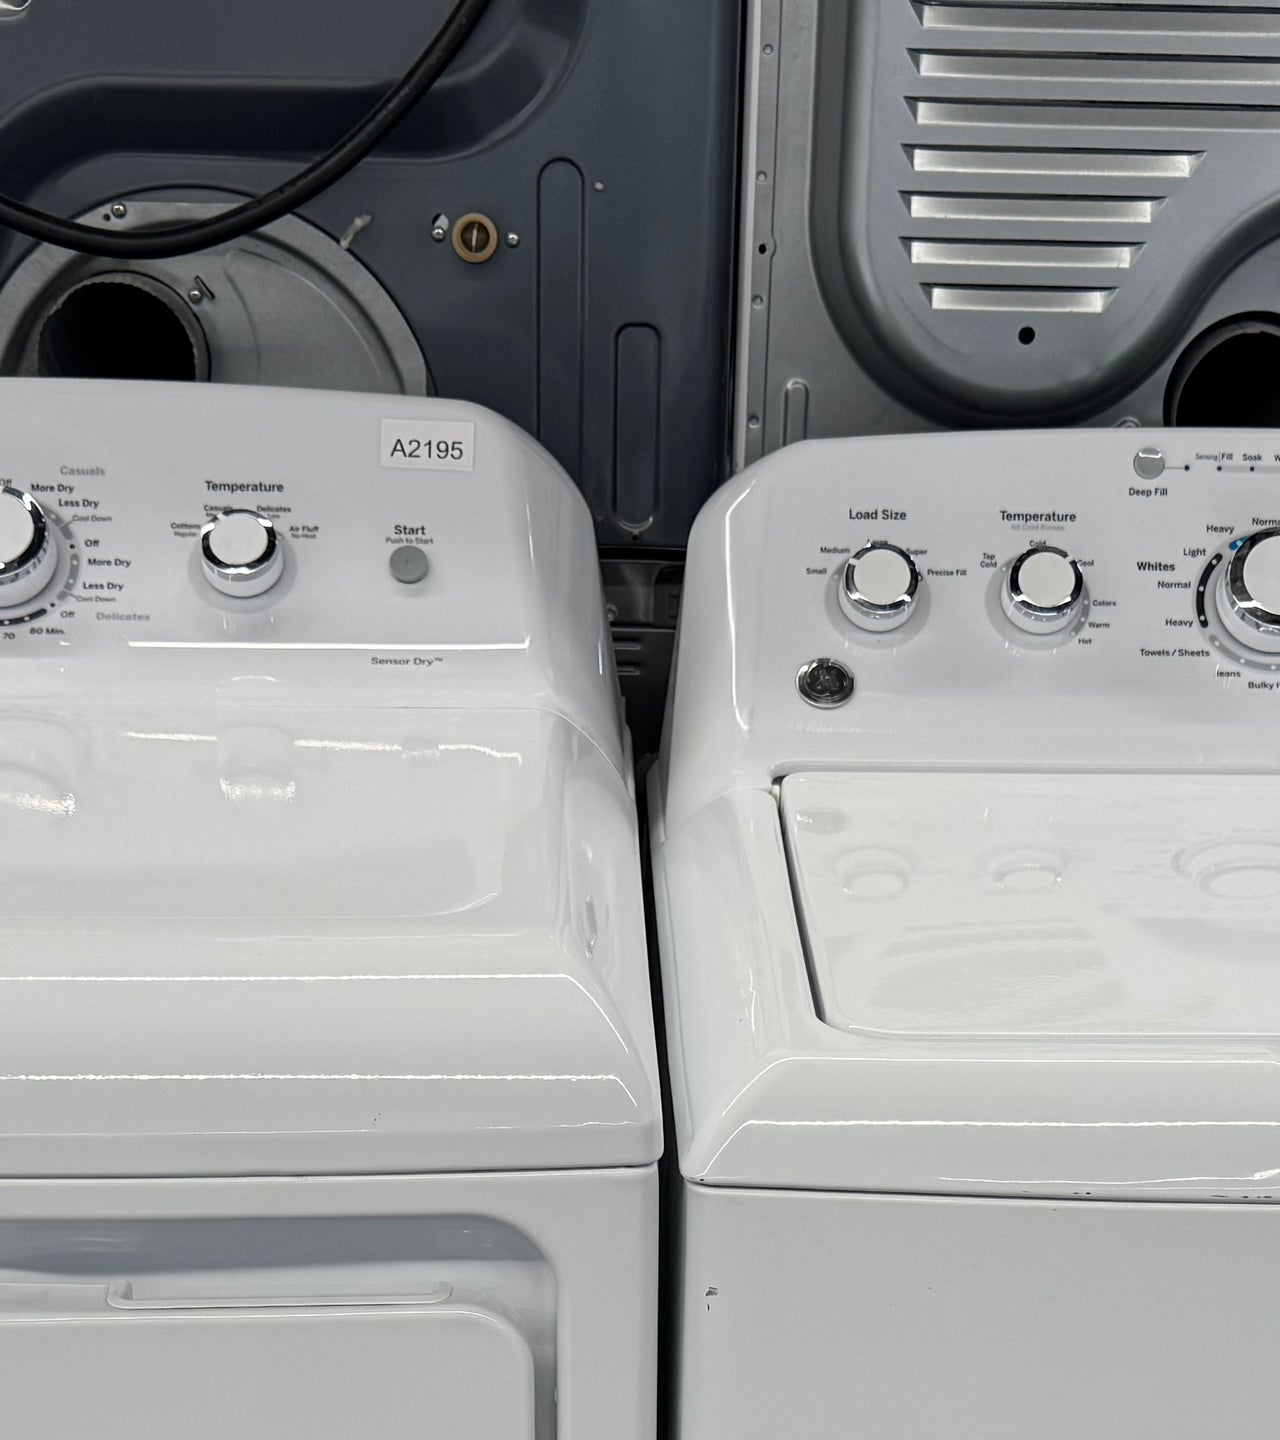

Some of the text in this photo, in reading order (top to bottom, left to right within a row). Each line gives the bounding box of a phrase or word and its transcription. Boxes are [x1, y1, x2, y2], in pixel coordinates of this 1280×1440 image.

[390, 438, 463, 460] A2195
[1221, 453, 1233, 461] Fill
[1242, 453, 1262, 462] Soak
[60, 466, 106, 477] Casuals
[31, 483, 75, 494] More Dry
[205, 480, 285, 494] Temperature
[1128, 487, 1168, 497] Deep Fill
[59, 499, 99, 509] Less Dry
[256, 505, 292, 513] Delicates
[849, 508, 907, 521] Load Size
[1000, 510, 1077, 523] Temperature
[302, 525, 319, 533] Fluff
[394, 524, 426, 536] Start
[1206, 524, 1235, 535] Heavy
[84, 539, 99, 548] Off
[385, 536, 404, 544] Push
[415, 537, 434, 545] Start
[1029, 540, 1047, 548] Cold
[1183, 548, 1207, 558] Light
[87, 558, 132, 568] More Dry
[1137, 562, 1176, 572] Whites
[806, 567, 827, 575] Small
[927, 569, 967, 577] Precise Fill
[83, 581, 124, 592] Less Dry
[1157, 580, 1191, 589] Normal
[1092, 599, 1117, 607] Colors
[60, 610, 75, 618] Off
[96, 611, 151, 622] Delicates
[1165, 618, 1193, 628] Heavy
[2, 632, 16, 640] 70
[29, 627, 43, 635] 80
[1140, 648, 1170, 657] Towels
[1178, 649, 1210, 657] Sheets
[371, 657, 411, 666] Sensor
[1248, 681, 1274, 691] Bulky
